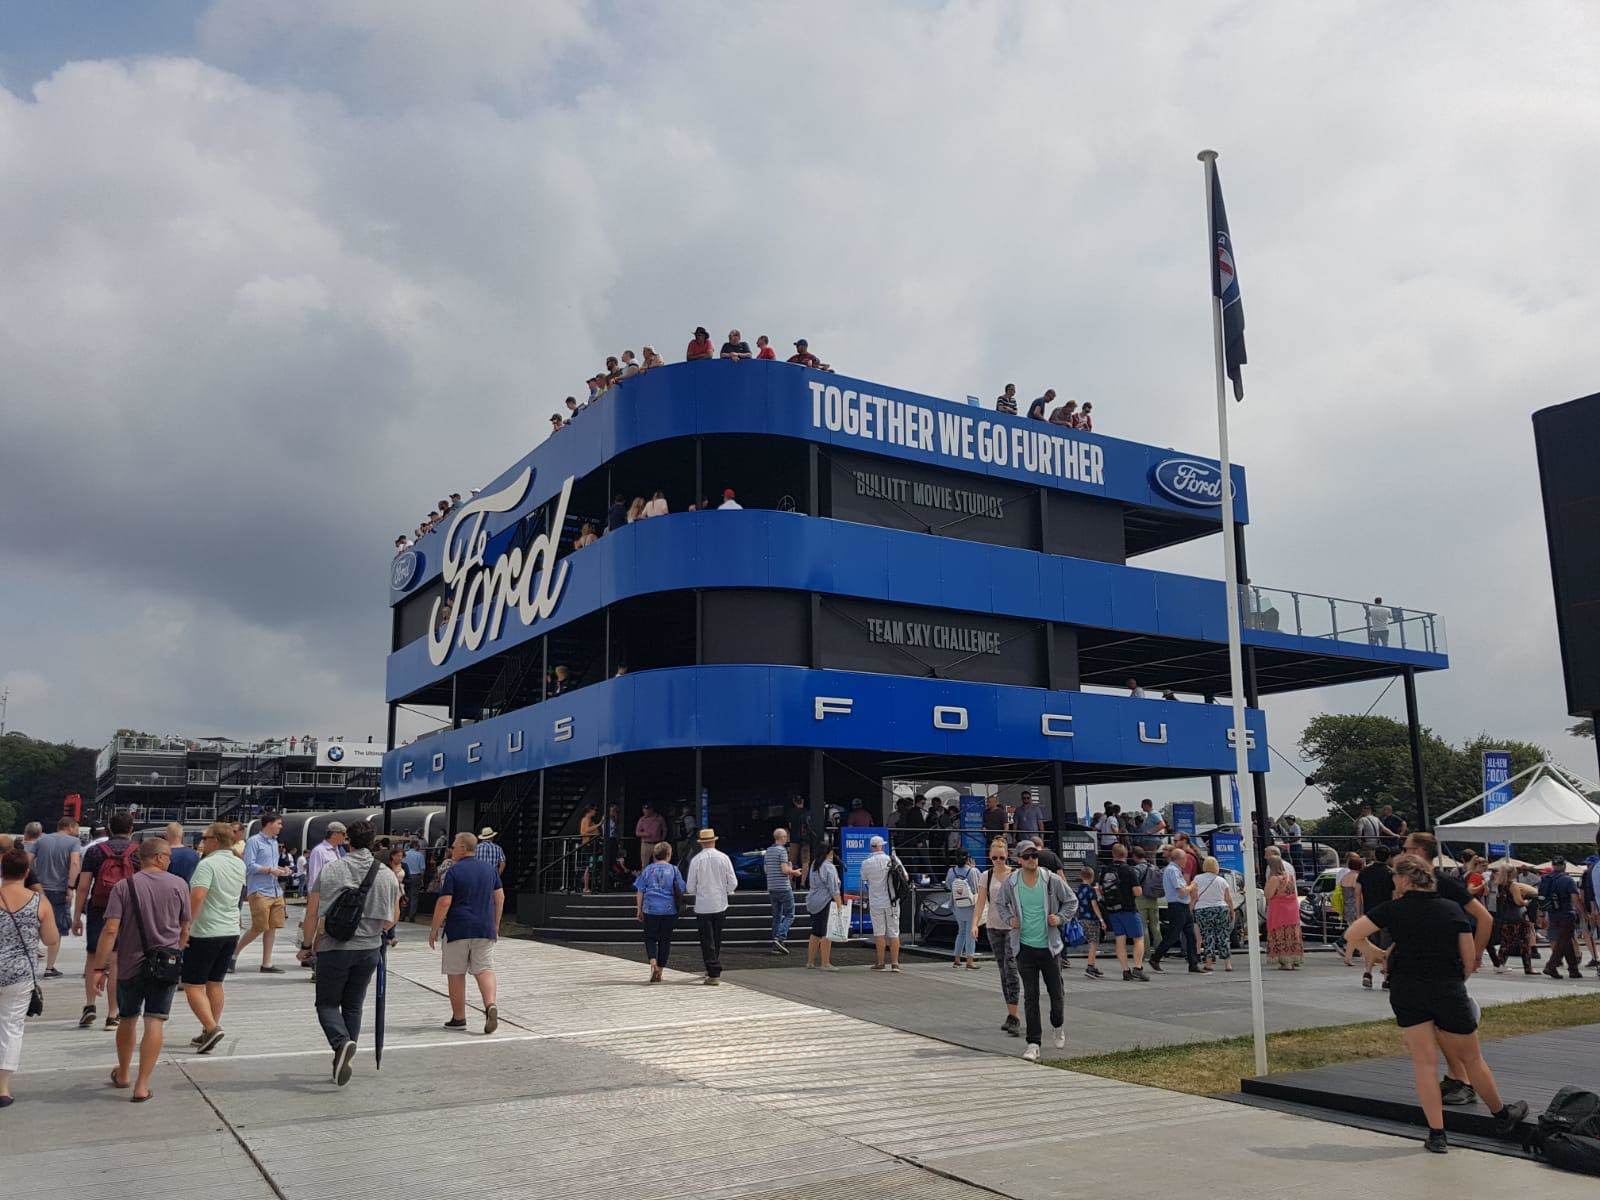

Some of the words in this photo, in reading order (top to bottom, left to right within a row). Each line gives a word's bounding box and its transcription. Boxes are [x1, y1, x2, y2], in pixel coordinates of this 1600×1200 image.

[809, 381, 934, 452] TOGETHER
[938, 411, 974, 460] WE
[977, 420, 1008, 466] GO
[1011, 427, 1105, 485] FURTHER
[913, 482, 952, 510] MOVIE
[954, 490, 1004, 519] STUDIOS
[1173, 464, 1221, 498] Ford
[428, 466, 575, 666] Ford
[867, 618, 904, 645] TEAM
[906, 622, 931, 648] SKY
[933, 625, 1001, 655] CHALLENGE
[814, 696, 1256, 750] FOCUS
[402, 716, 574, 780] FOCUS
[1486, 769, 1508, 782] FOCUS
